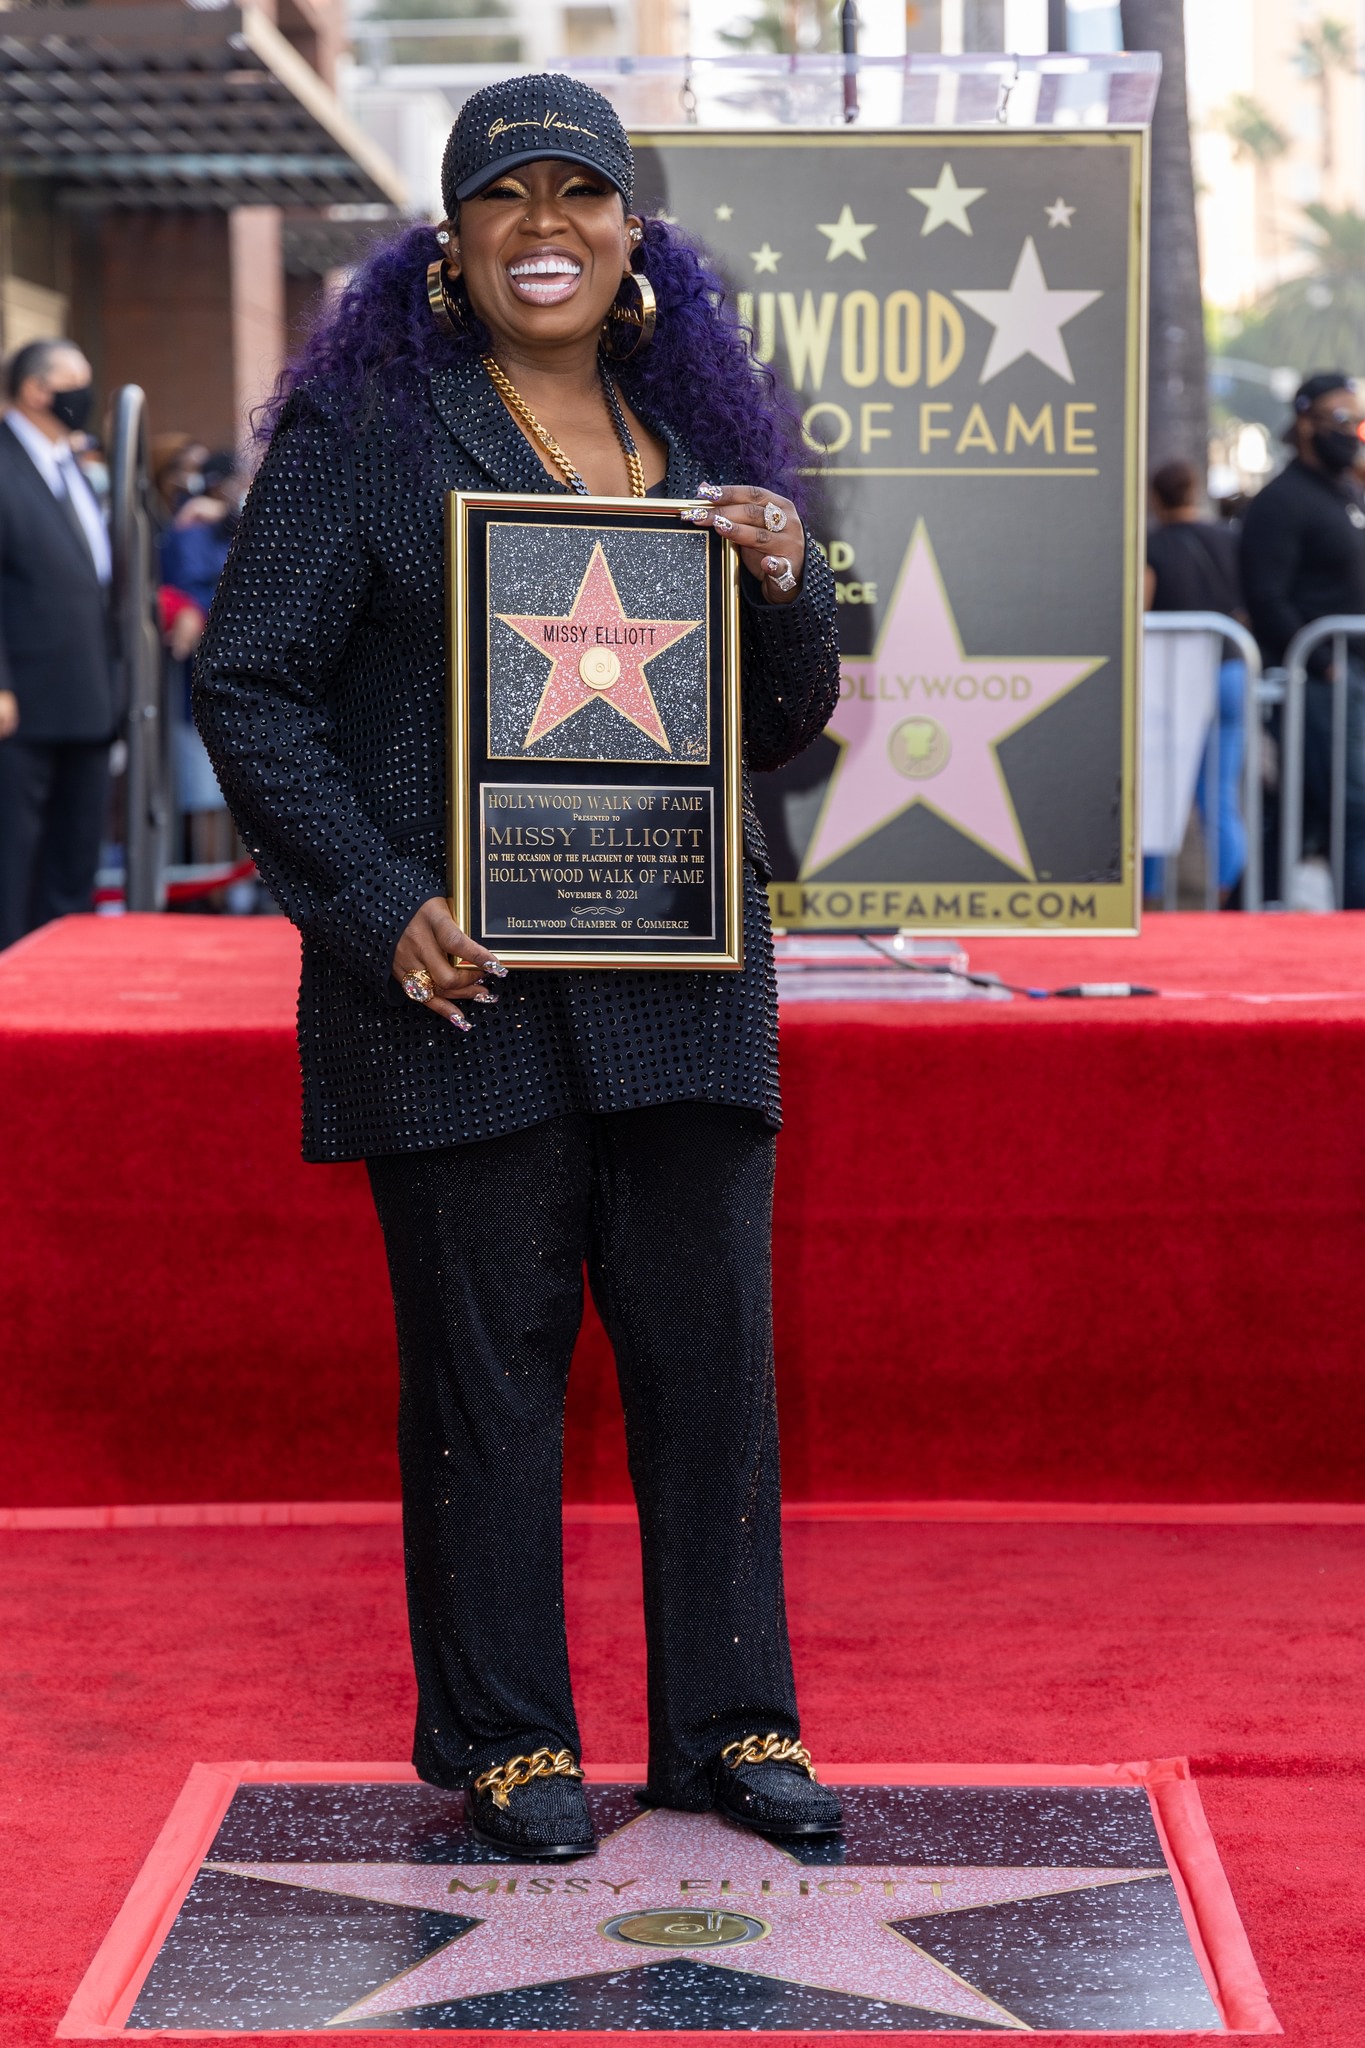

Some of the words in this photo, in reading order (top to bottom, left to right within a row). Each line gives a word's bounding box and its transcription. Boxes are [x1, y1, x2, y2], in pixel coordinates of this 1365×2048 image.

[737, 289, 966, 392] YWOOD
[802, 402, 894, 454] OF
[920, 402, 1098, 454] FAME
[543, 625, 588, 643] MISSY
[596, 626, 656, 645] ELLIOTT
[840, 674, 1033, 701] OLLYWOOD
[488, 794, 582, 810] HOLLYWOOD
[588, 796, 632, 810] WALK
[638, 796, 655, 810] OF
[662, 797, 704, 811] FAME
[489, 826, 577, 846] MISSY
[590, 827, 704, 848] ELLIOTT
[488, 853, 498, 861] ON
[517, 854, 550, 862] OCCASION
[553, 854, 562, 862] OF
[565, 854, 579, 862] THE
[582, 854, 622, 862] PLACEMENT
[625, 855, 633, 863] OF
[637, 855, 656, 863] YOUR
[659, 855, 677, 863] STAR
[680, 855, 689, 863] IN
[691, 855, 704, 863] THE
[489, 868, 583, 882] HOLLYWOOD
[589, 869, 634, 883] WALK
[639, 869, 658, 883] OF
[663, 870, 704, 884] FAME
[616, 890, 638, 899] 2021
[776, 891, 1097, 919] LKOFFAME.COM
[447, 1878, 638, 1895] MISSY
[679, 1878, 956, 1898] ELLIOTT
